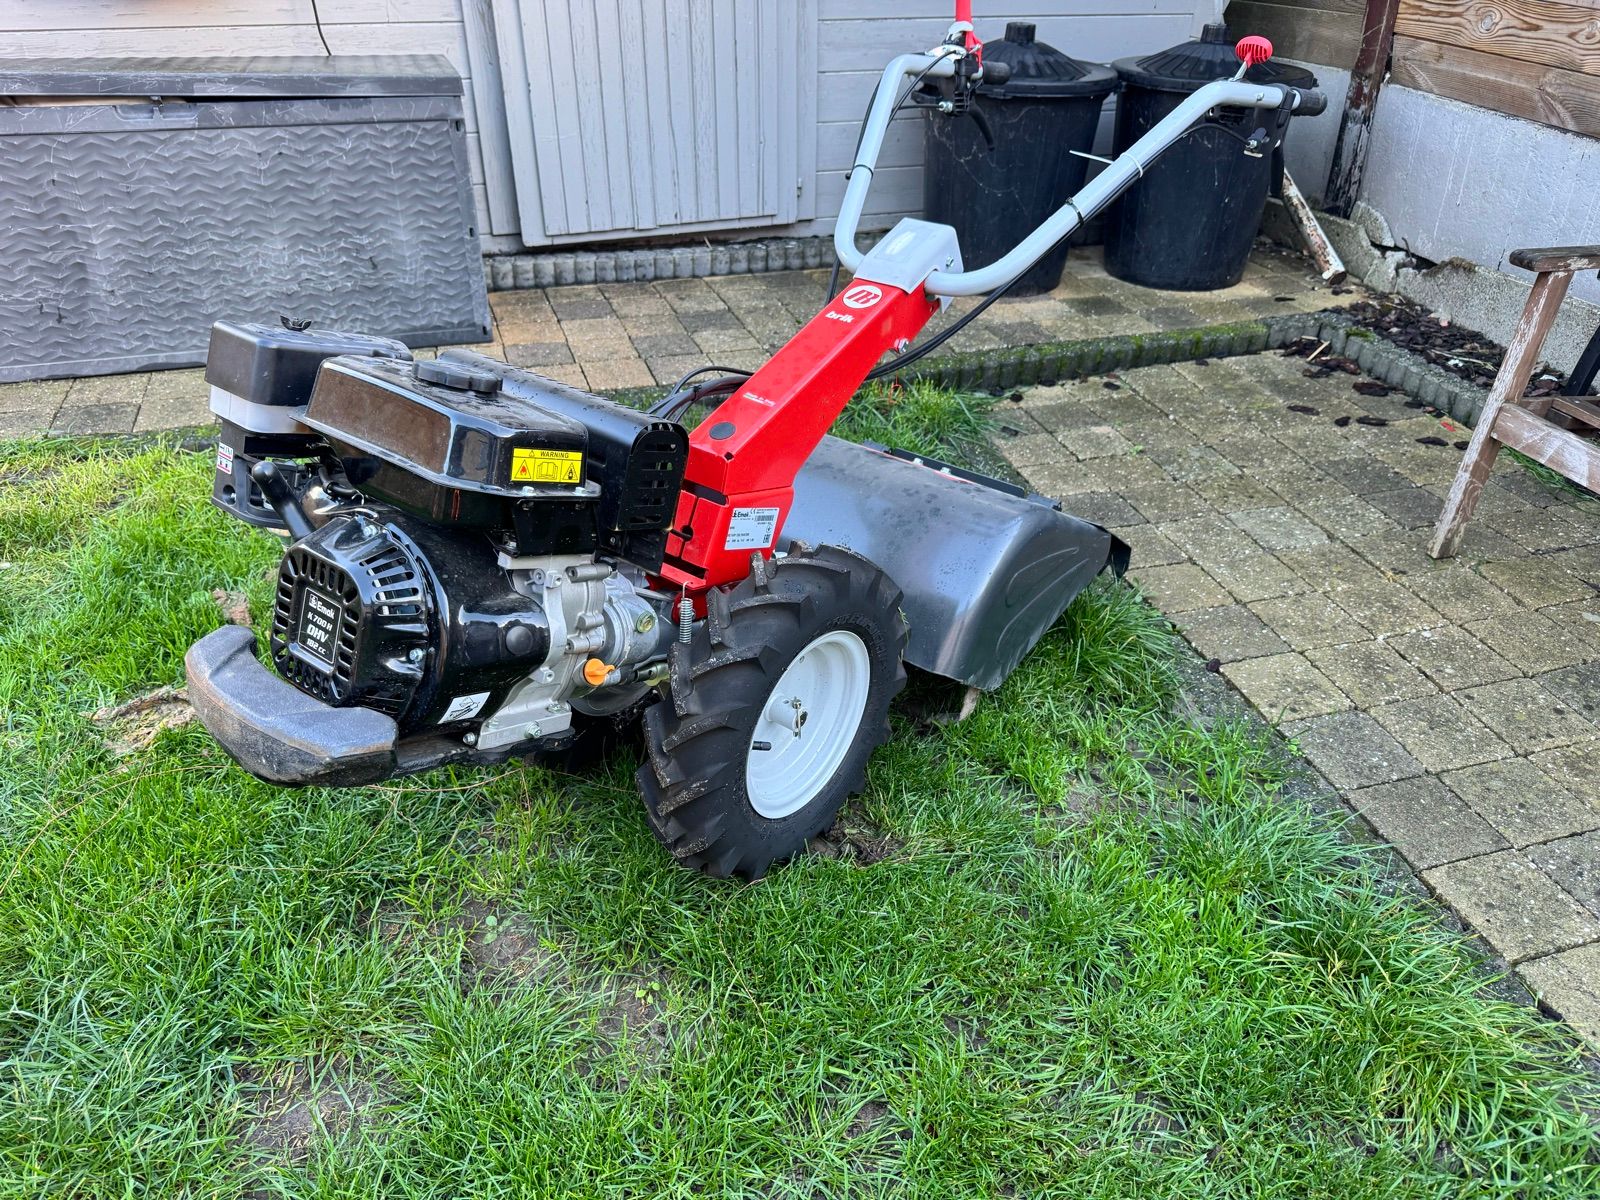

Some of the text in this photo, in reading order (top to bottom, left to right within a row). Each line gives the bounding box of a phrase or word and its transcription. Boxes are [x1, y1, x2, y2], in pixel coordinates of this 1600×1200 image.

[825, 311, 854, 323] brik
[317, 601, 335, 619] Emak
[307, 612, 333, 631] K 700 H
[306, 638, 319, 650] 182
